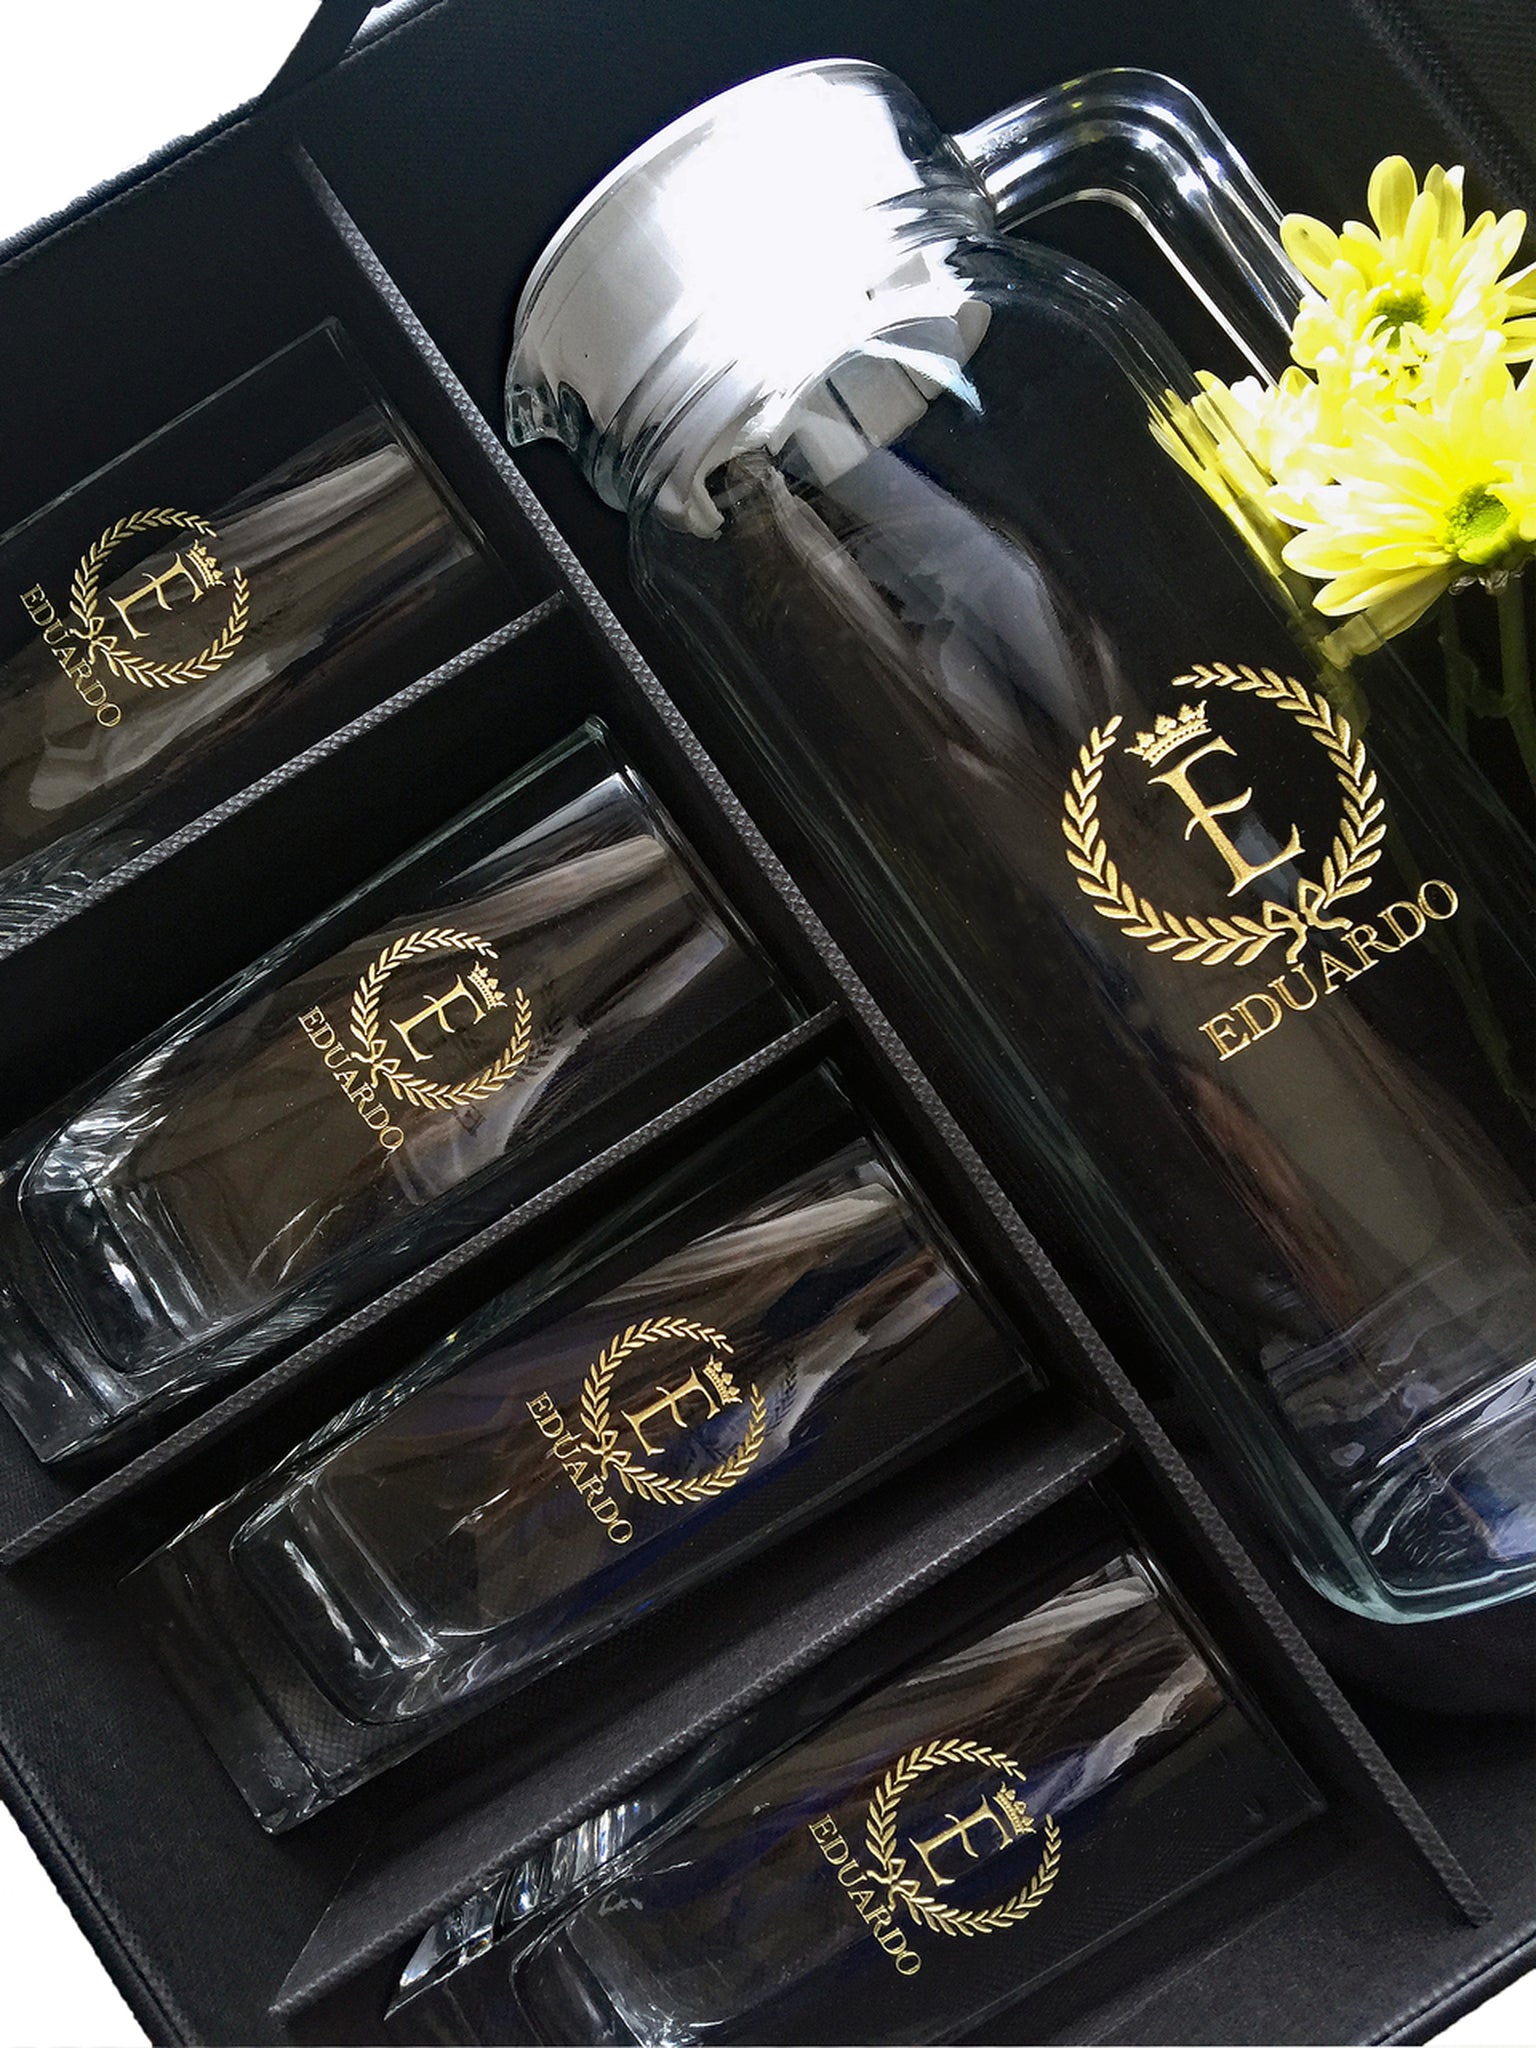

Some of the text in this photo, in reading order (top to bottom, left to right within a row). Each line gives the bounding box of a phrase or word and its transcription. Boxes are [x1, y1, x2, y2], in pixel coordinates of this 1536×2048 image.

[20, 583, 122, 727] EDUARDO
[108, 552, 204, 640] E
[1147, 735, 1306, 897] E
[389, 974, 487, 1063] E
[1199, 879, 1459, 1061] EDUARDO
[298, 1005, 404, 1150] EDUARDO
[525, 1391, 634, 1544] EDUARDO
[620, 1366, 721, 1456] E
[808, 1814, 922, 1976] EDUARDO
[908, 1794, 1014, 1887] E
